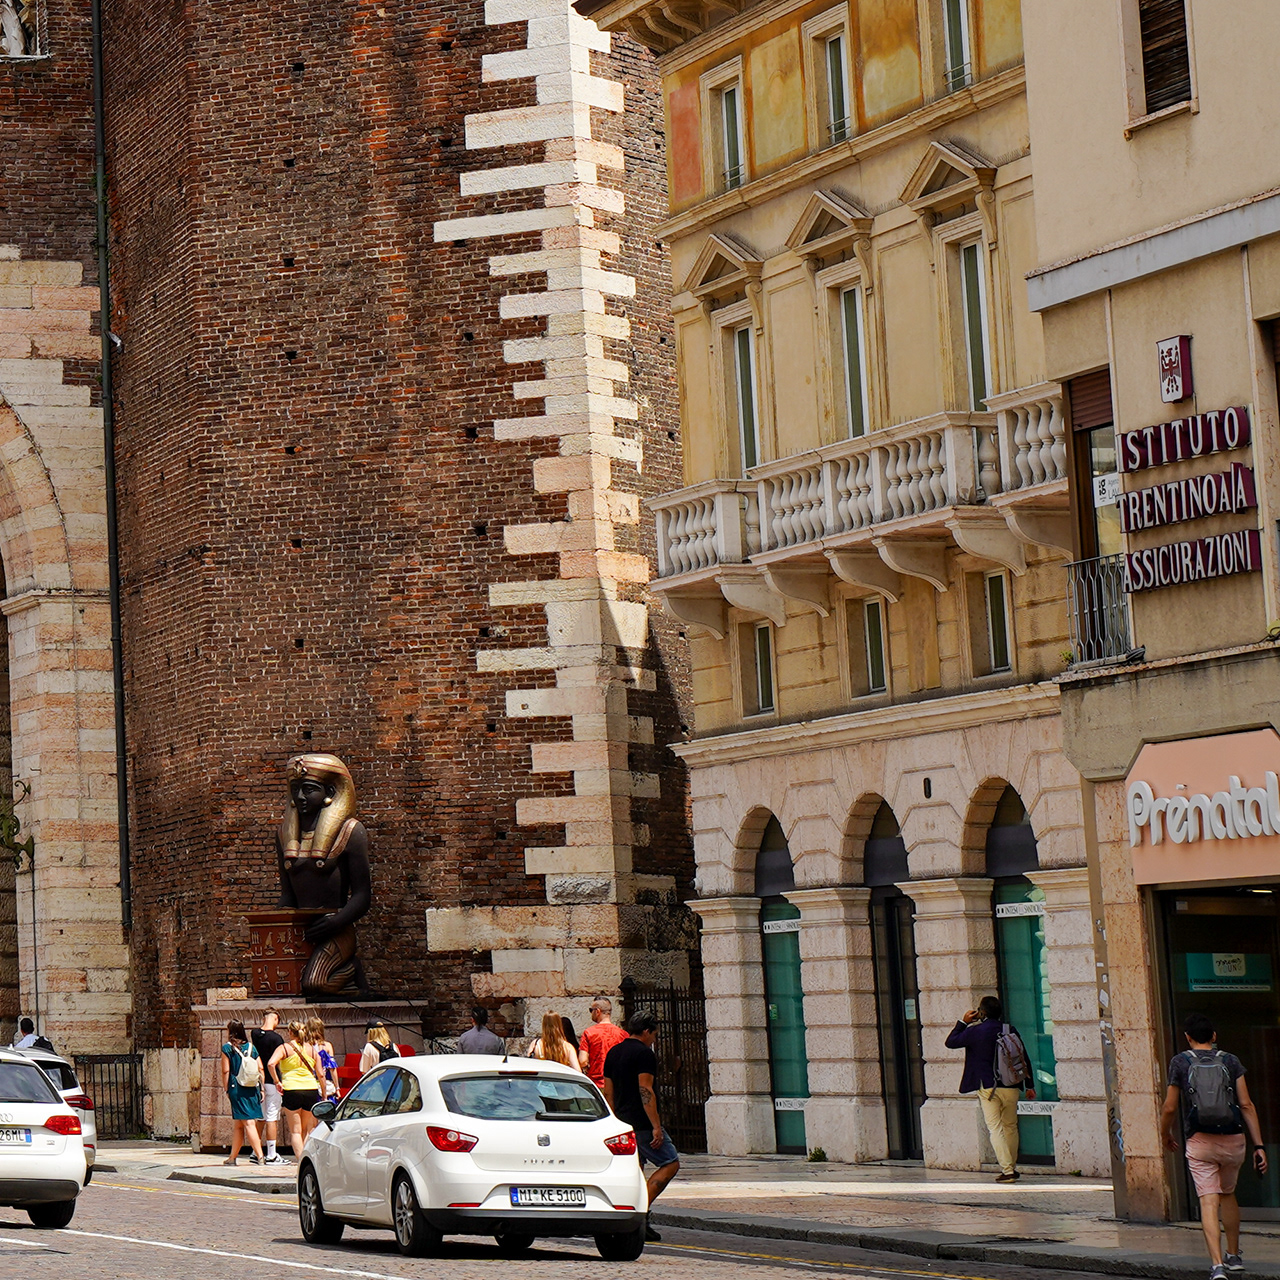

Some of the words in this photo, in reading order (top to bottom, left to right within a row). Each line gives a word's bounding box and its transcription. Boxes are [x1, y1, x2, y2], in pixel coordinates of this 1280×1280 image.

[1116, 407, 1240, 473] ISTITUTO
[1122, 529, 1253, 593] ASSICURAZIONI
[540, 1189, 554, 1202] KE
[556, 1189, 583, 1202] 5100
